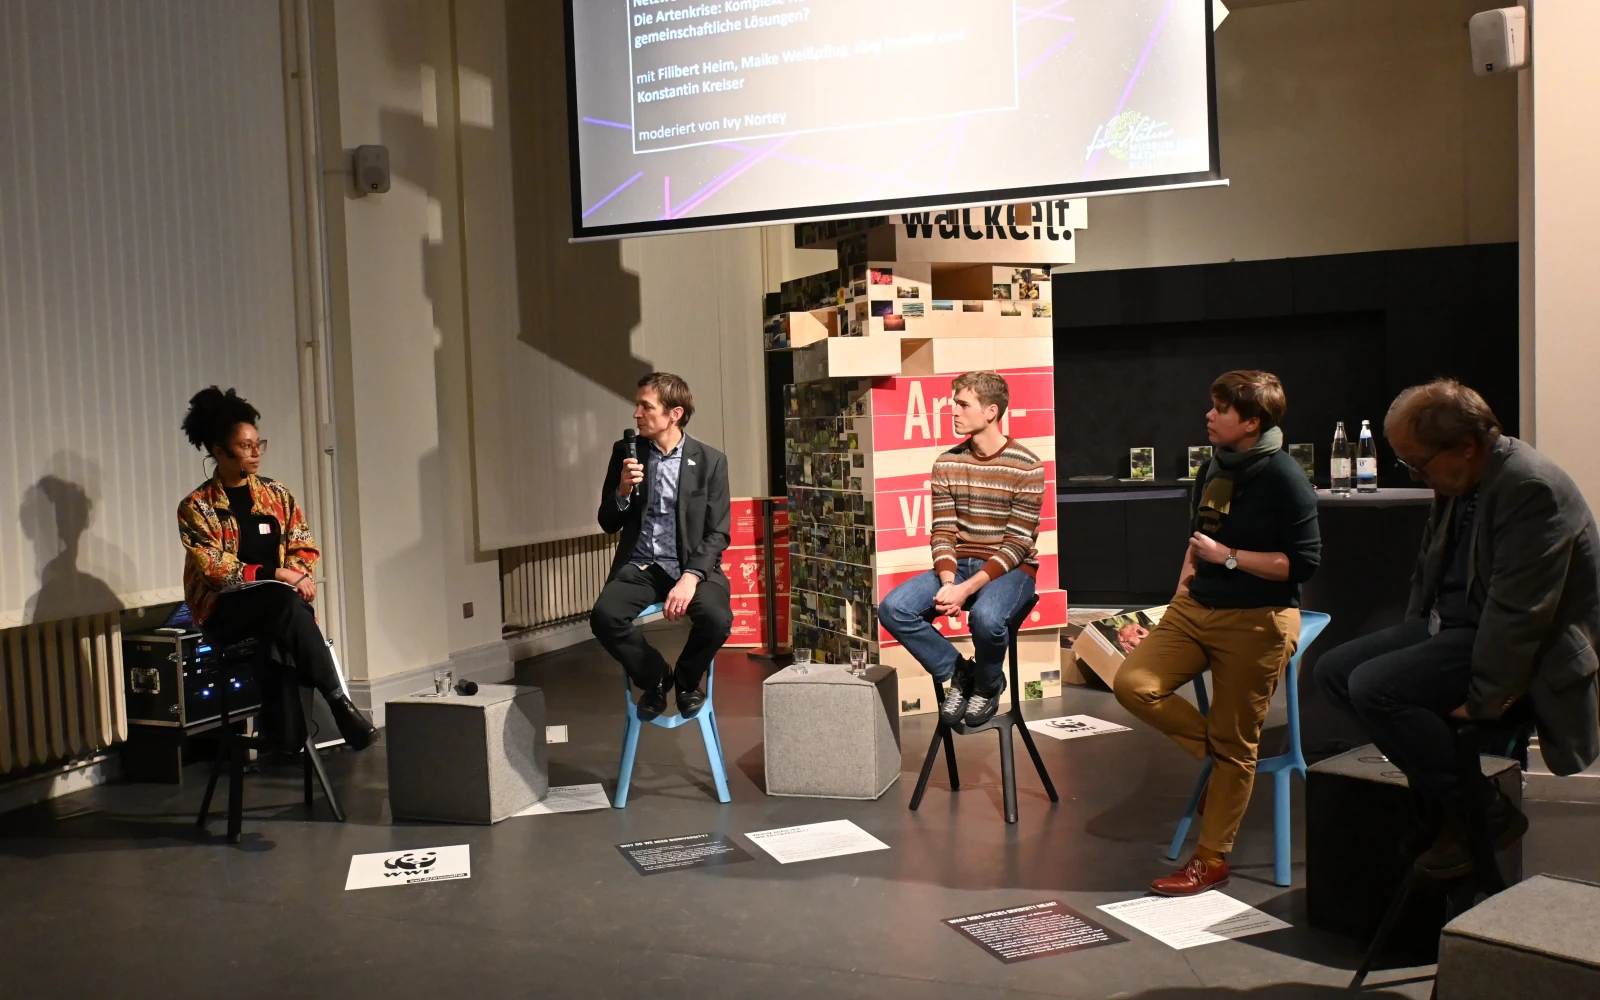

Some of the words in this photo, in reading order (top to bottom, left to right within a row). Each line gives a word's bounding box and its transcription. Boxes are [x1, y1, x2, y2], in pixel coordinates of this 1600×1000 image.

[634, 12, 653, 26] Die
[655, 4, 722, 23] Artenkrise:
[634, 20, 742, 48] gemeinschaftliche
[744, 7, 810, 29] Lösungen?
[636, 72, 656, 84] mit
[658, 64, 700, 80] Filibert
[702, 60, 738, 75] Heim,
[741, 53, 779, 69] Maike
[637, 83, 700, 103] Konstantin
[702, 77, 745, 93] Kreiser
[639, 121, 696, 141] moderiert
[698, 120, 720, 132] von
[723, 117, 741, 131] Ivy
[744, 112, 787, 127] Nortey
[384, 867, 436, 878] WWF
